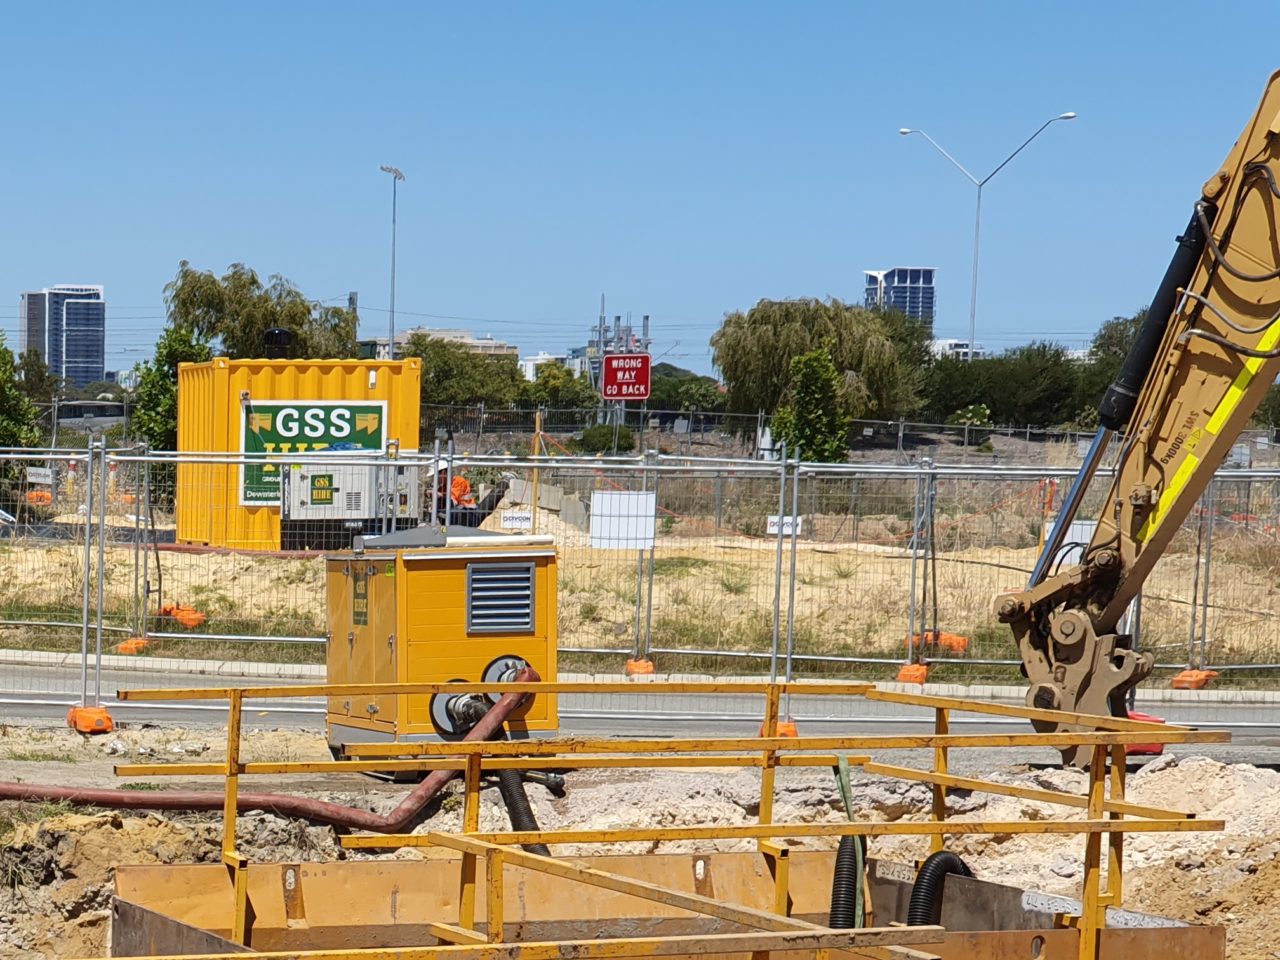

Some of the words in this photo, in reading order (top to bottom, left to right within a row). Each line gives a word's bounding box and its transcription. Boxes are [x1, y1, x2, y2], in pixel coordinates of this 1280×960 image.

[612, 359, 642, 368] WRONG
[617, 371, 636, 380] WAY
[606, 385, 617, 394] GO
[622, 385, 645, 394] BACK
[276, 408, 351, 437] GSS
[1160, 432, 1187, 464] 3000kg
